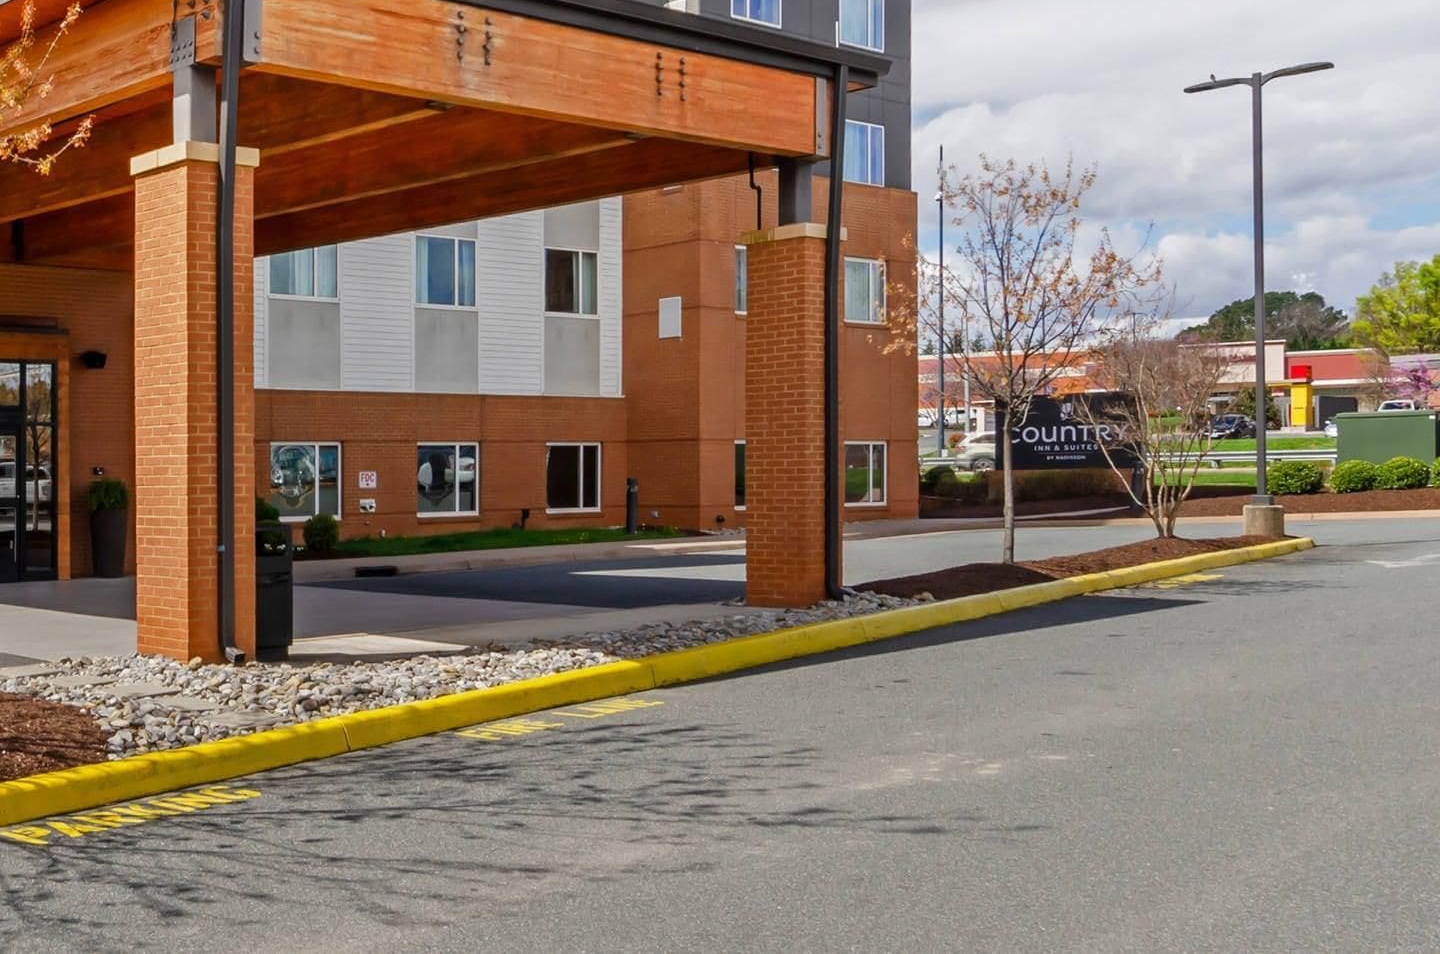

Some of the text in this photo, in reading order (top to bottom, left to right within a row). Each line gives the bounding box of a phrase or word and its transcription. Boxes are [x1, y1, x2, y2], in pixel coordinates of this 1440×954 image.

[1033, 444, 1051, 452] INN
[361, 473, 375, 483] FDC
[454, 698, 664, 740] FIRE LANE
[0, 785, 262, 846] PARKING
